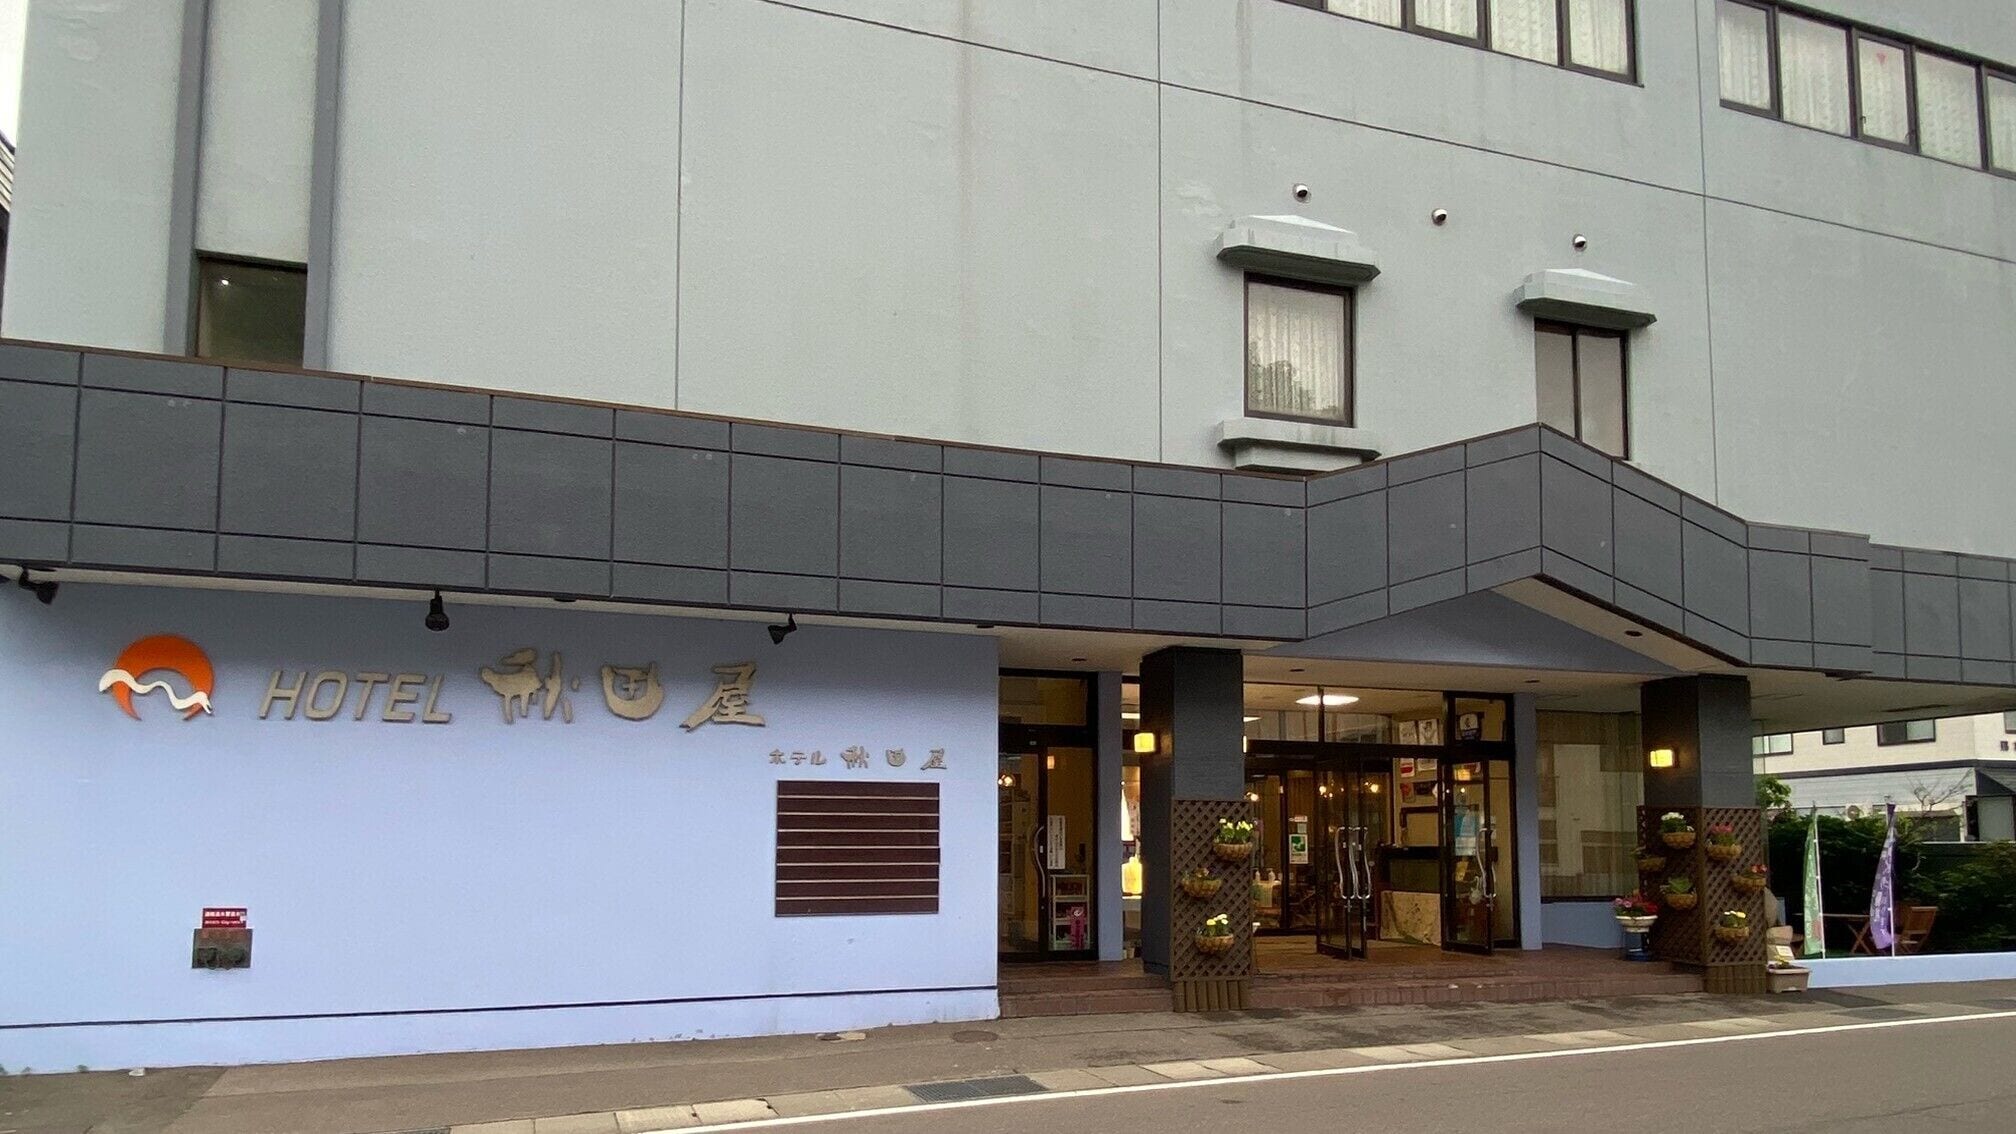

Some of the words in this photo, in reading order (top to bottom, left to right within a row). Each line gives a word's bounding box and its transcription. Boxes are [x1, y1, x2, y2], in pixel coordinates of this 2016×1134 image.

[258, 669, 453, 724] HOTEL
[479, 647, 767, 732] 秋田屋
[768, 748, 827, 766] ホテル
[840, 745, 948, 771] 秋田屋
